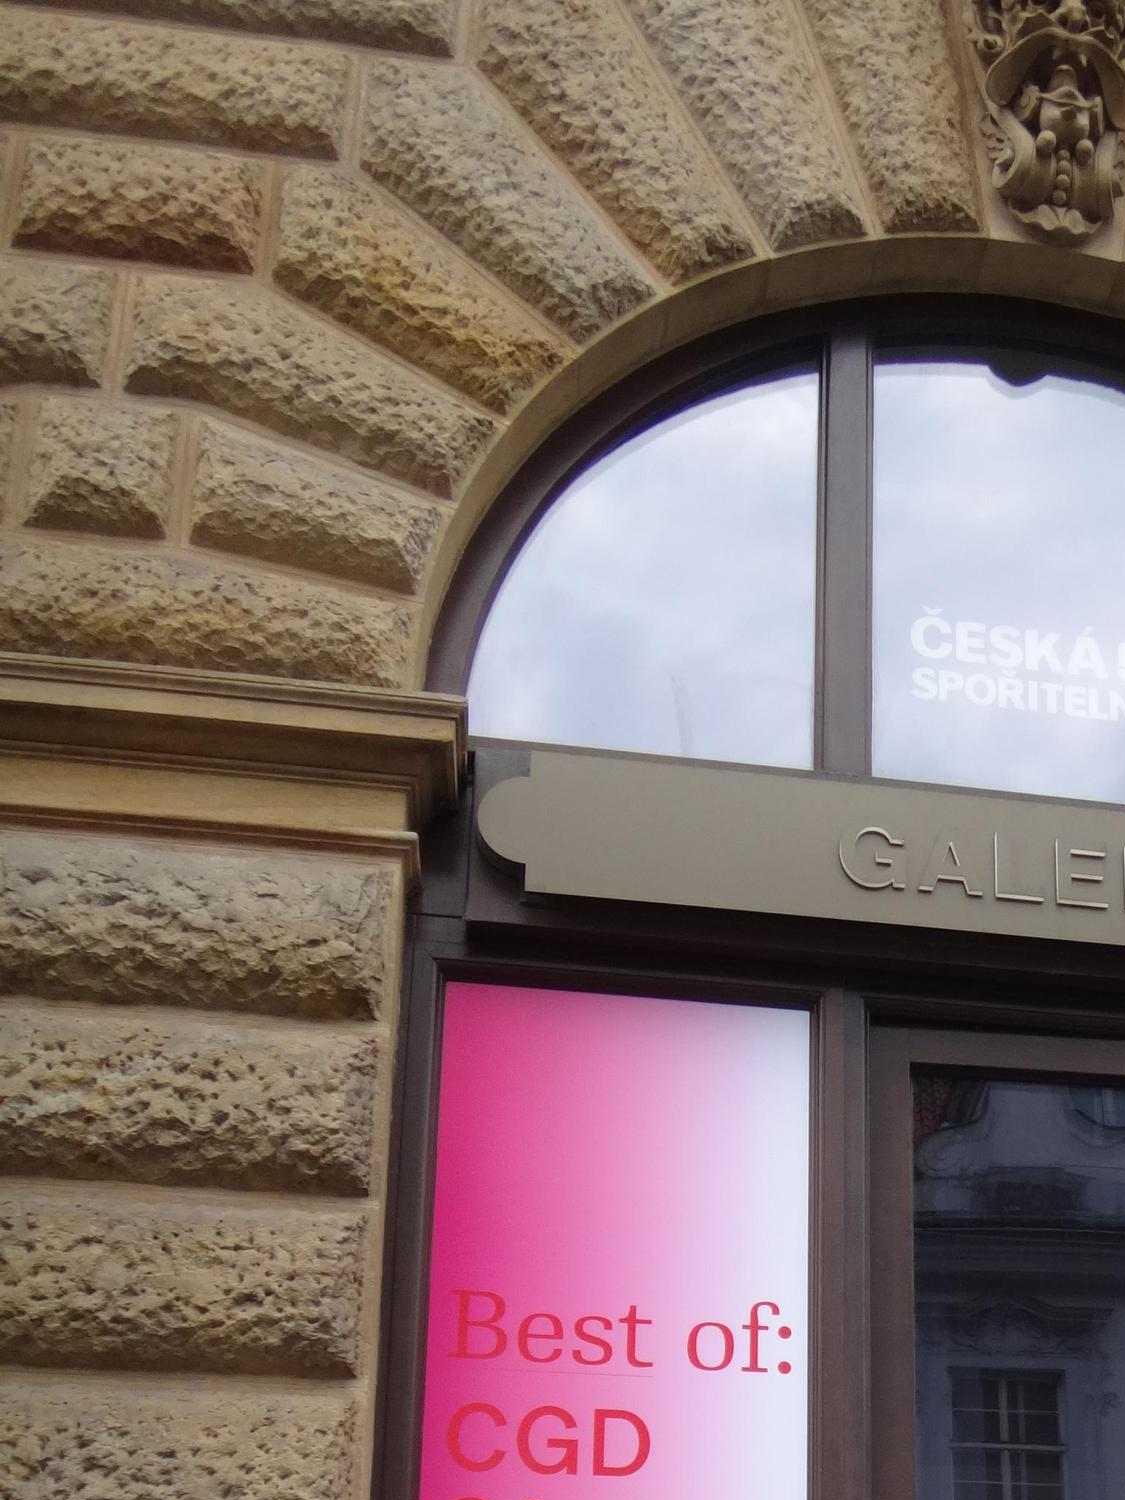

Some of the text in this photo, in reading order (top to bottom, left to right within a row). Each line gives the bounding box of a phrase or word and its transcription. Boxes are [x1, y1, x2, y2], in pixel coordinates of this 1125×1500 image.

[910, 605, 1109, 680] ČESKÁ
[446, 1289, 792, 1375] Best of:
[445, 1403, 651, 1477] CGD
